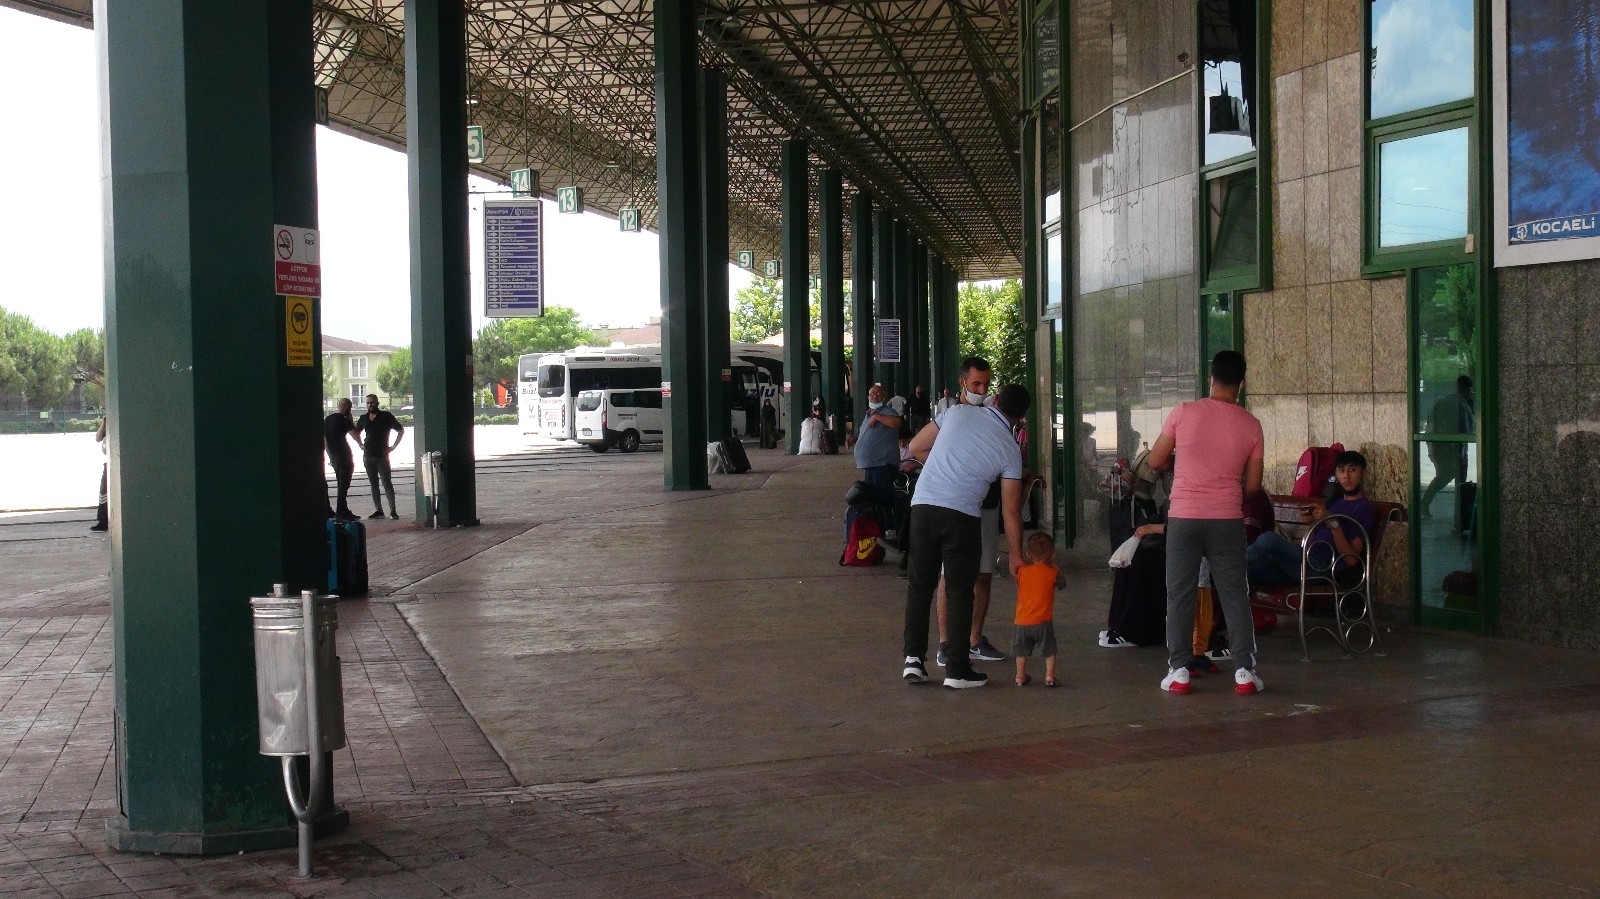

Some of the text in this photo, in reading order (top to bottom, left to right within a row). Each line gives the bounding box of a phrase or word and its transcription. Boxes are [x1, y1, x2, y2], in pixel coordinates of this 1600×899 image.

[513, 171, 529, 196] 14
[559, 189, 575, 212] 13
[621, 210, 636, 231] 12
[739, 252, 750, 268] 9
[766, 261, 775, 276] 8
